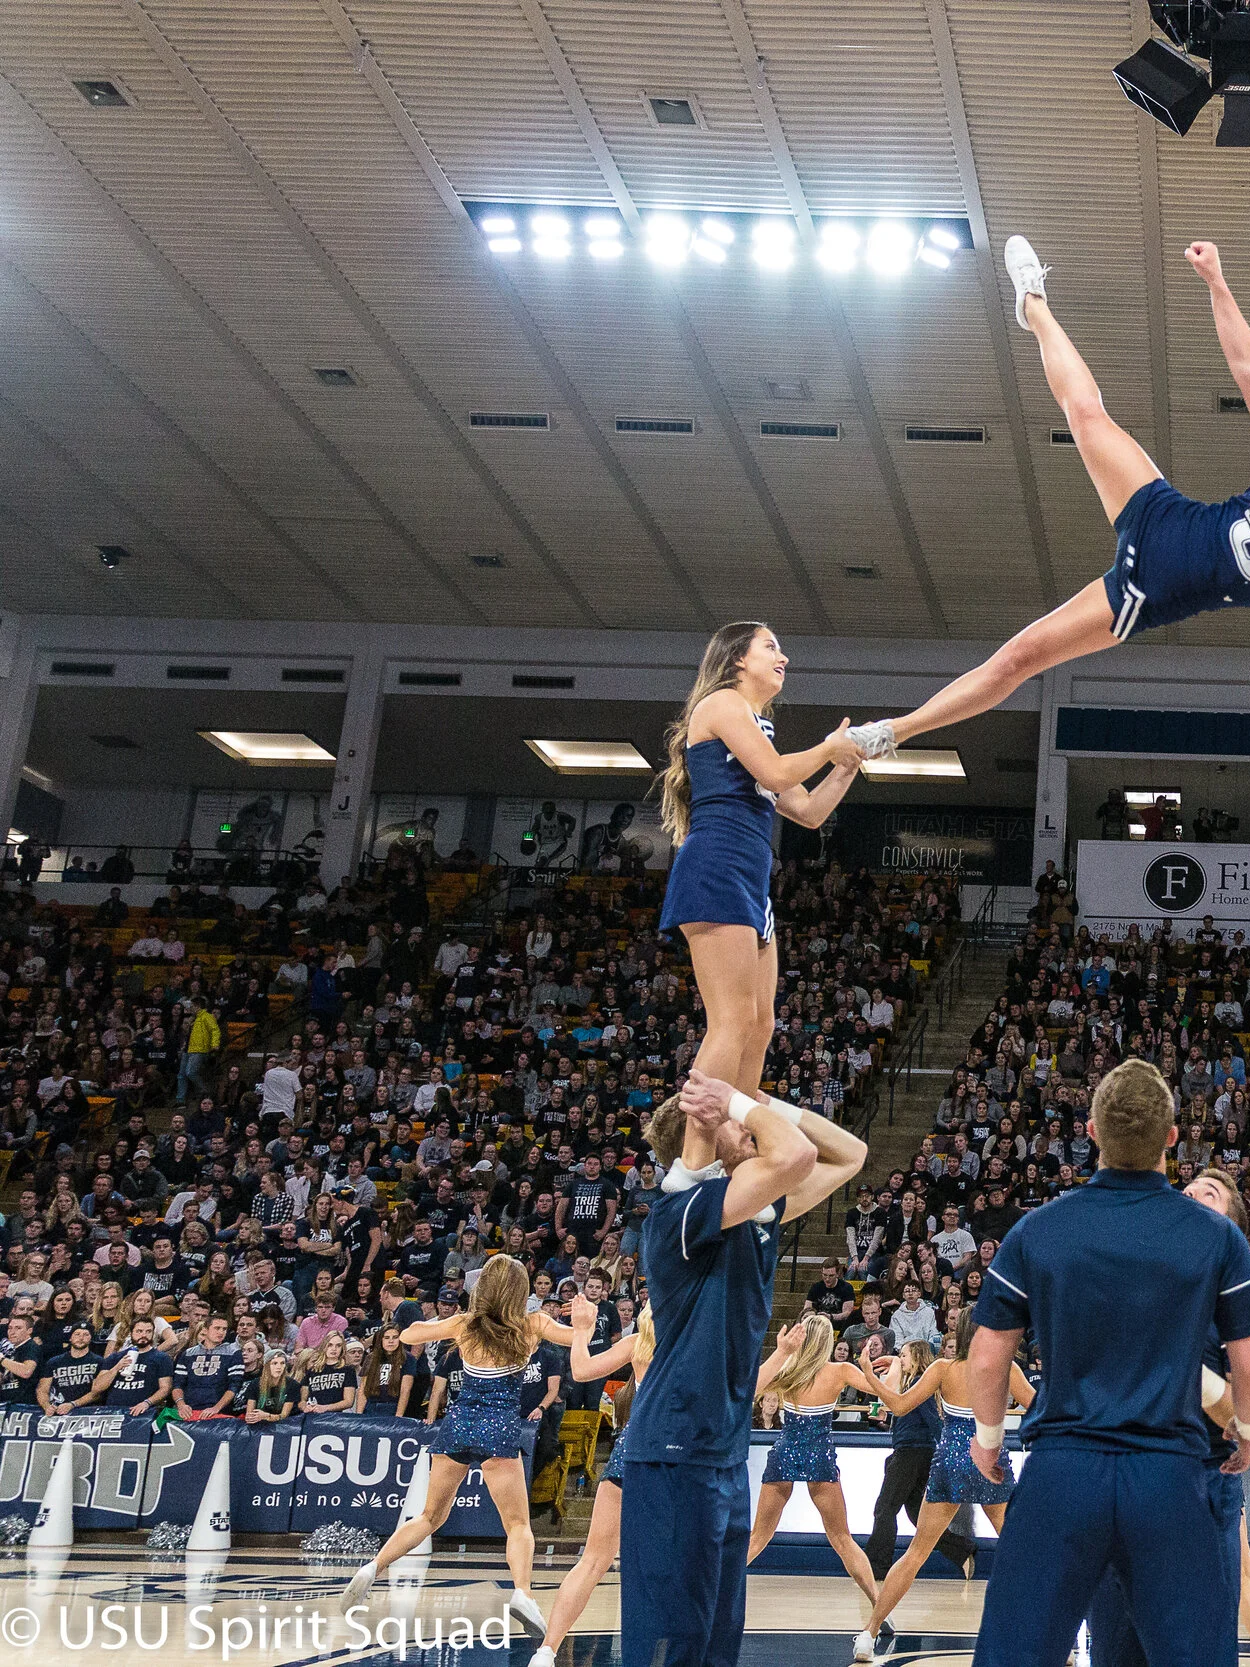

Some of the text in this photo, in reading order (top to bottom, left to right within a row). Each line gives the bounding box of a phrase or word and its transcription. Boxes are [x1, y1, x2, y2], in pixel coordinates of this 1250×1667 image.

[338, 796, 350, 811] J
[1044, 815, 1056, 830] L
[881, 845, 966, 871] CONSERVICE
[1160, 865, 1189, 900] F
[1211, 893, 1249, 905] Home
[1093, 922, 1116, 931] 2175
[1118, 922, 1143, 931] Noh
[574, 1195, 601, 1206] TRUE
[573, 1205, 599, 1216] BLUE
[53, 1363, 99, 1378] AGGIES
[309, 1372, 346, 1385] AGGIES
[321, 1380, 344, 1391] WAY
[37, 1414, 125, 1438] STATE
[256, 1434, 392, 1486] USU
